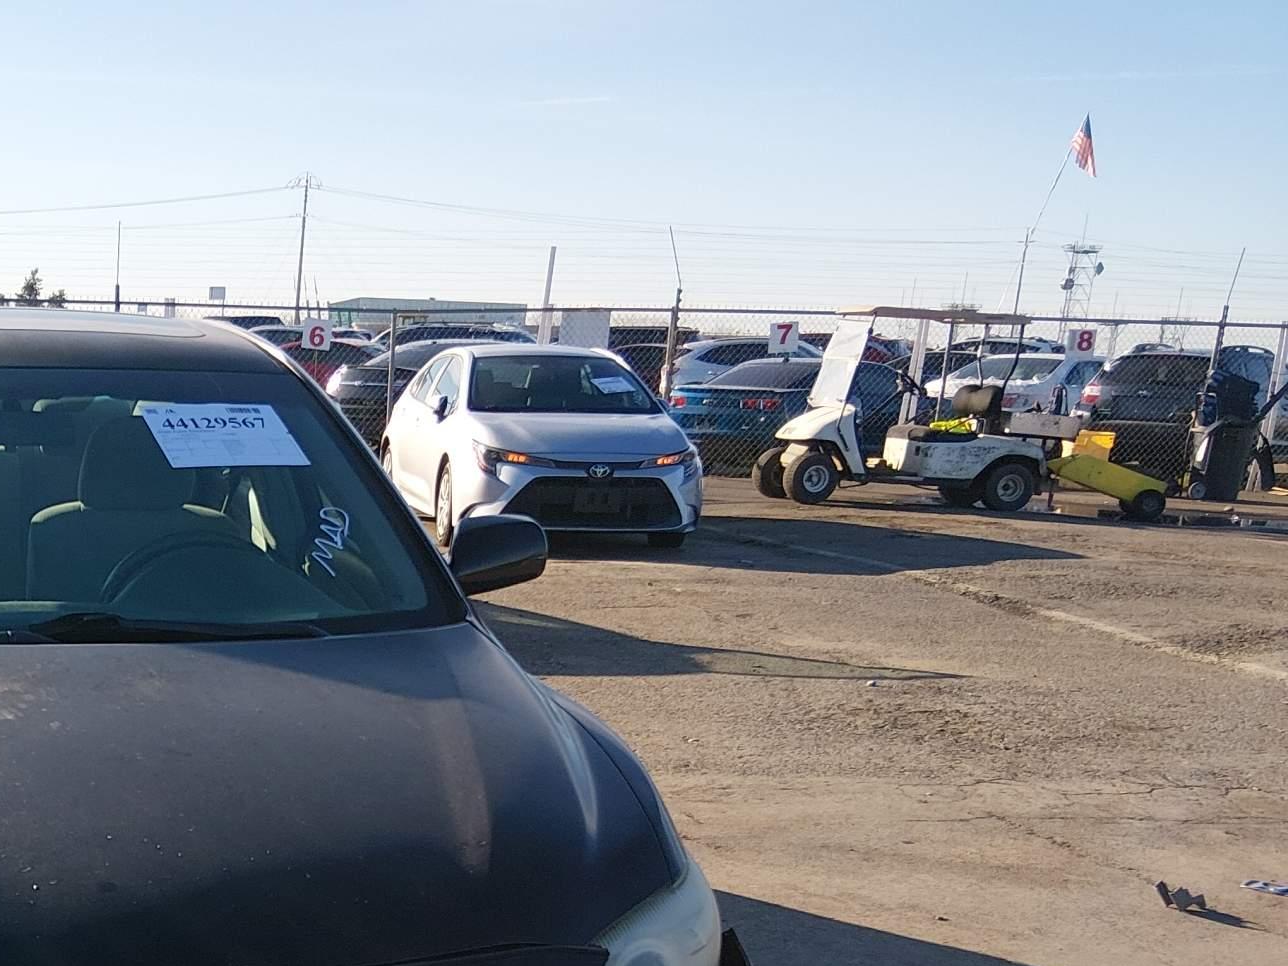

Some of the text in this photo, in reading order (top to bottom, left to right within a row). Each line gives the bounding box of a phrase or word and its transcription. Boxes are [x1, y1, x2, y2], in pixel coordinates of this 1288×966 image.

[309, 326, 324, 347] 6
[777, 324, 793, 345] 7
[1077, 330, 1093, 352] 8
[162, 416, 266, 430] 44129567
